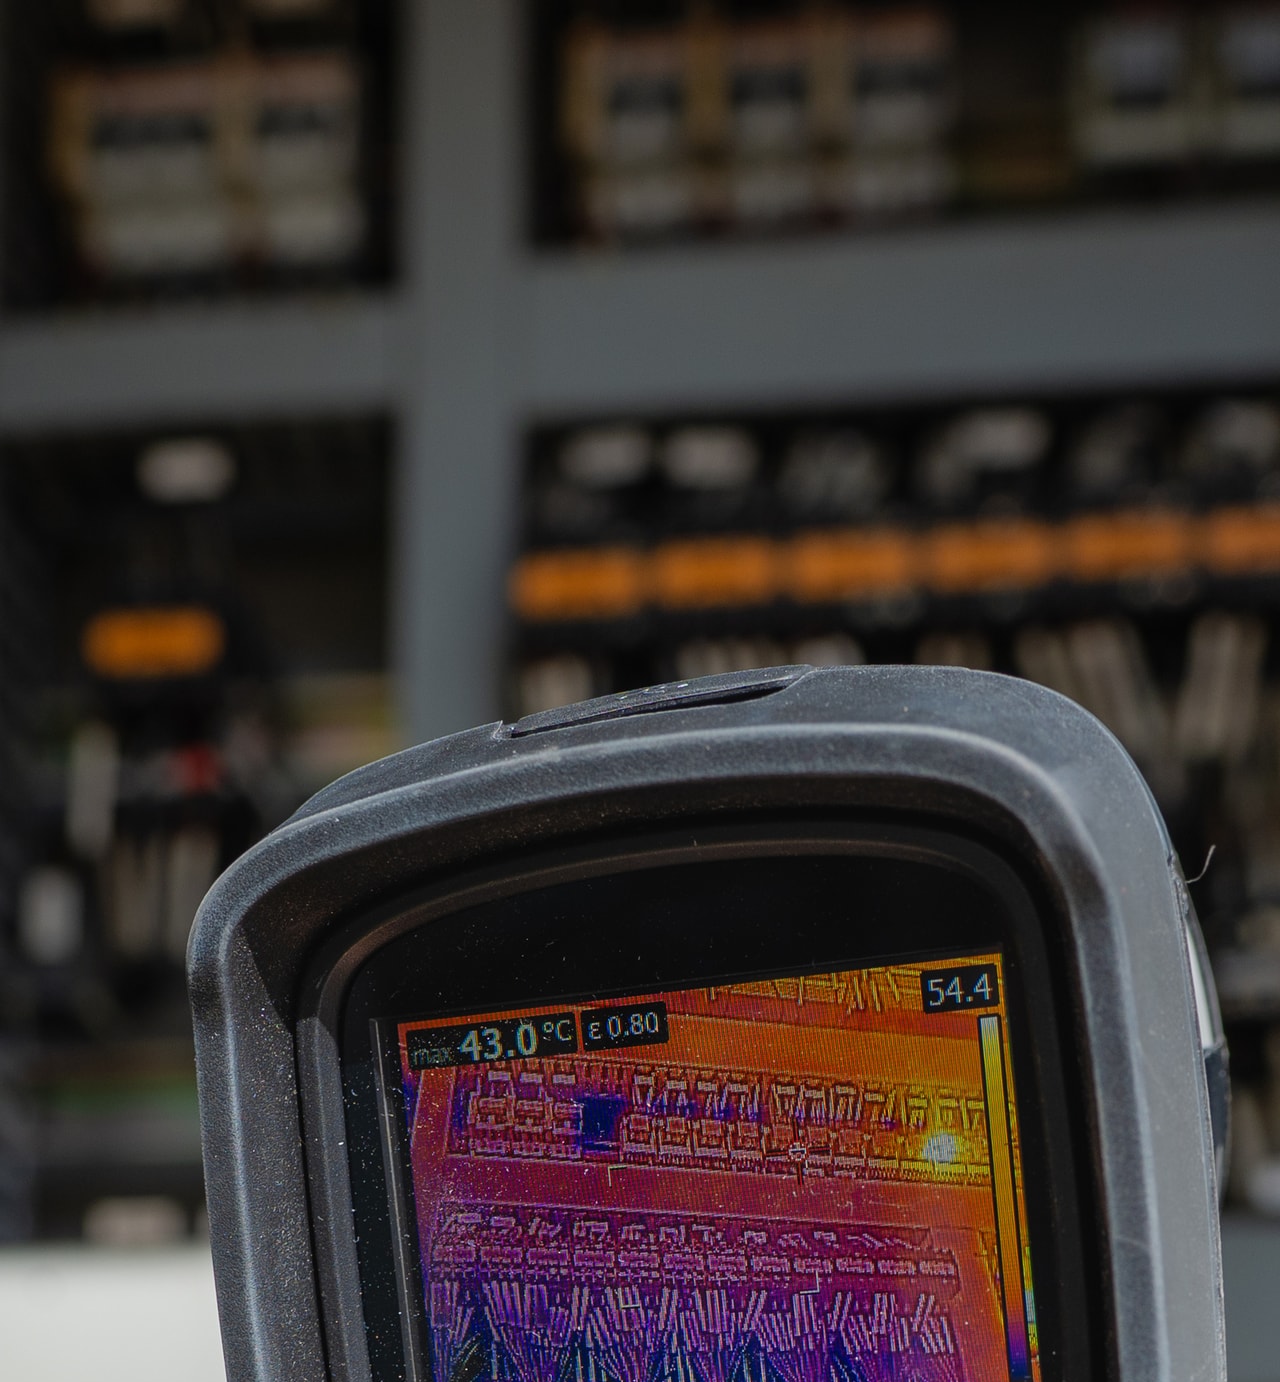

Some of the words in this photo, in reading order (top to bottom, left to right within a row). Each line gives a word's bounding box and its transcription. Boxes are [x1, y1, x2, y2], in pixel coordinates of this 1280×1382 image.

[927, 973, 992, 1006] 54.4
[607, 1012, 659, 1037] 0.80
[459, 1023, 537, 1061] 43.0
